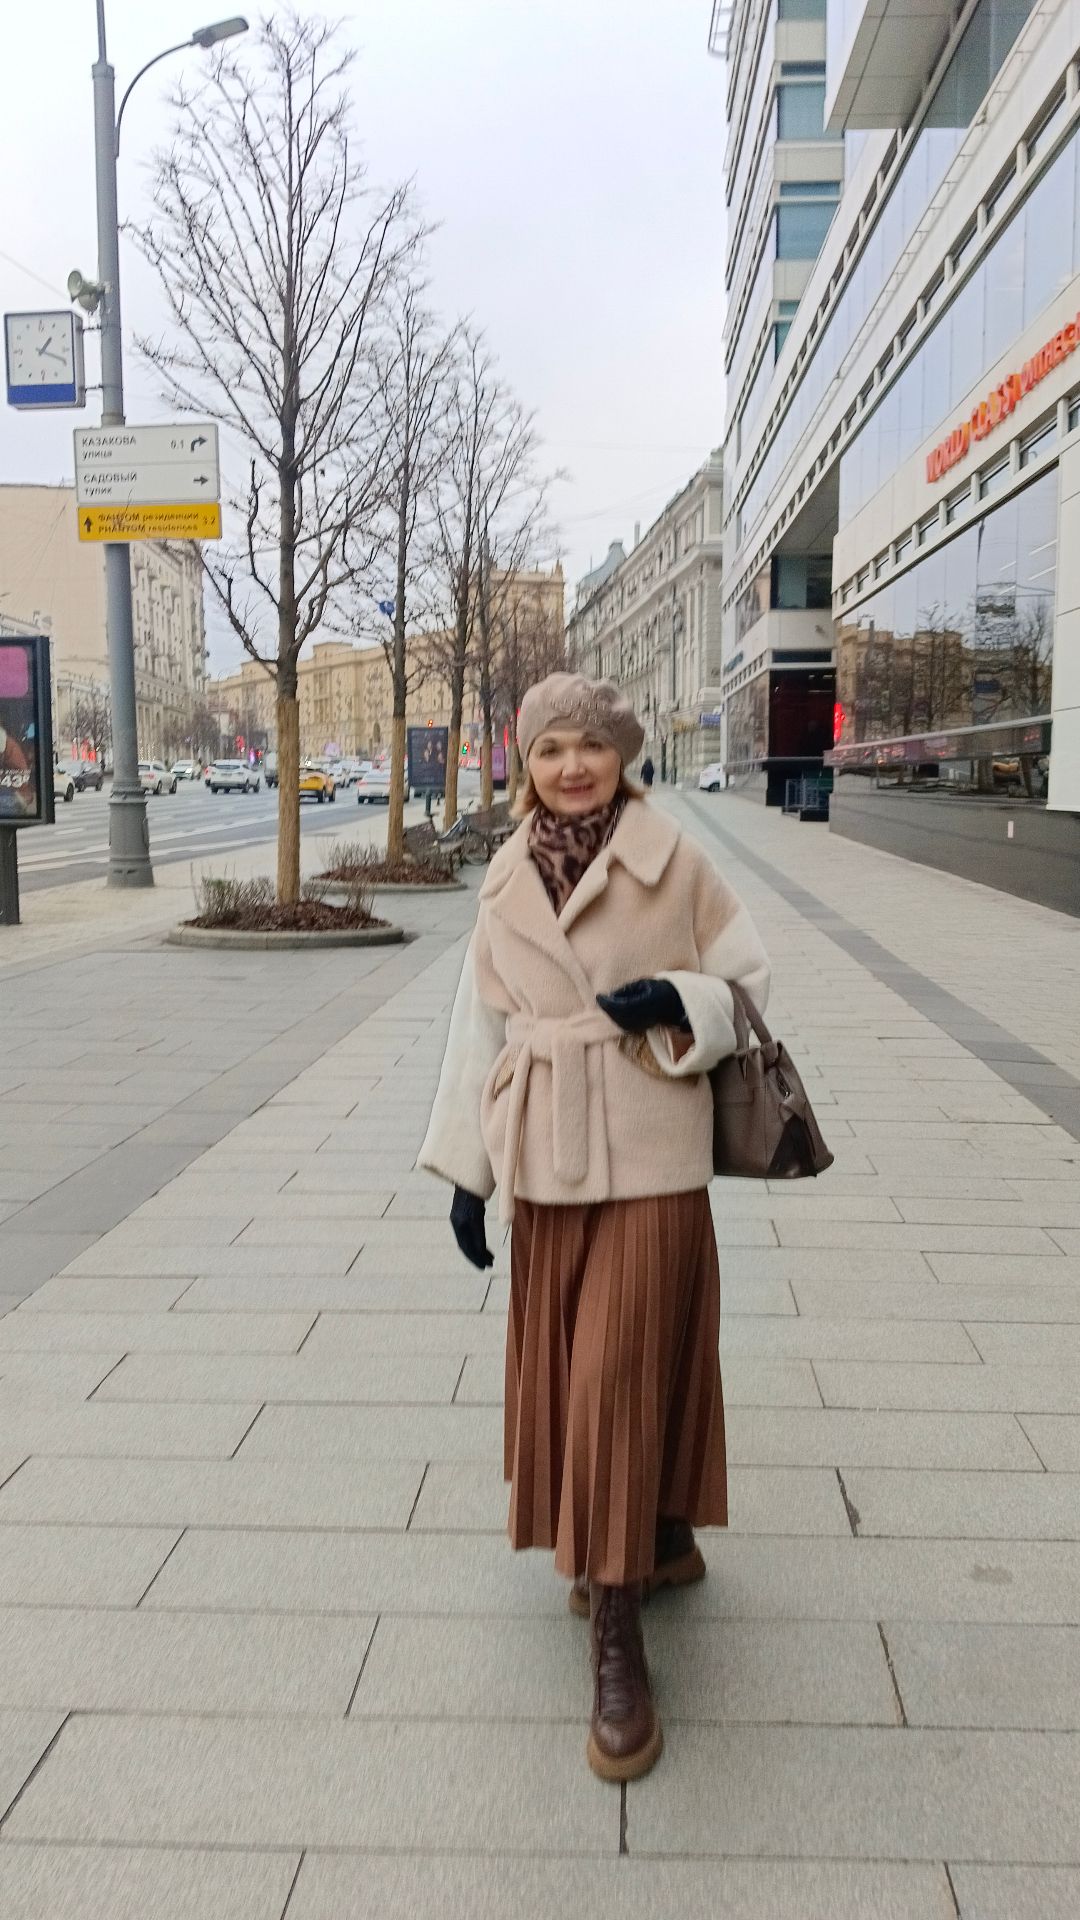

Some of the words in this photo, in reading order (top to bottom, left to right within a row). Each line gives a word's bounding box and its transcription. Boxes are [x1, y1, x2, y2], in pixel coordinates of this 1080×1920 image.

[82, 435, 137, 448] КАЗАКОВА
[82, 450, 112, 461] улица
[83, 471, 137, 485] САДОВЫЙ
[84, 487, 112, 496] тупик
